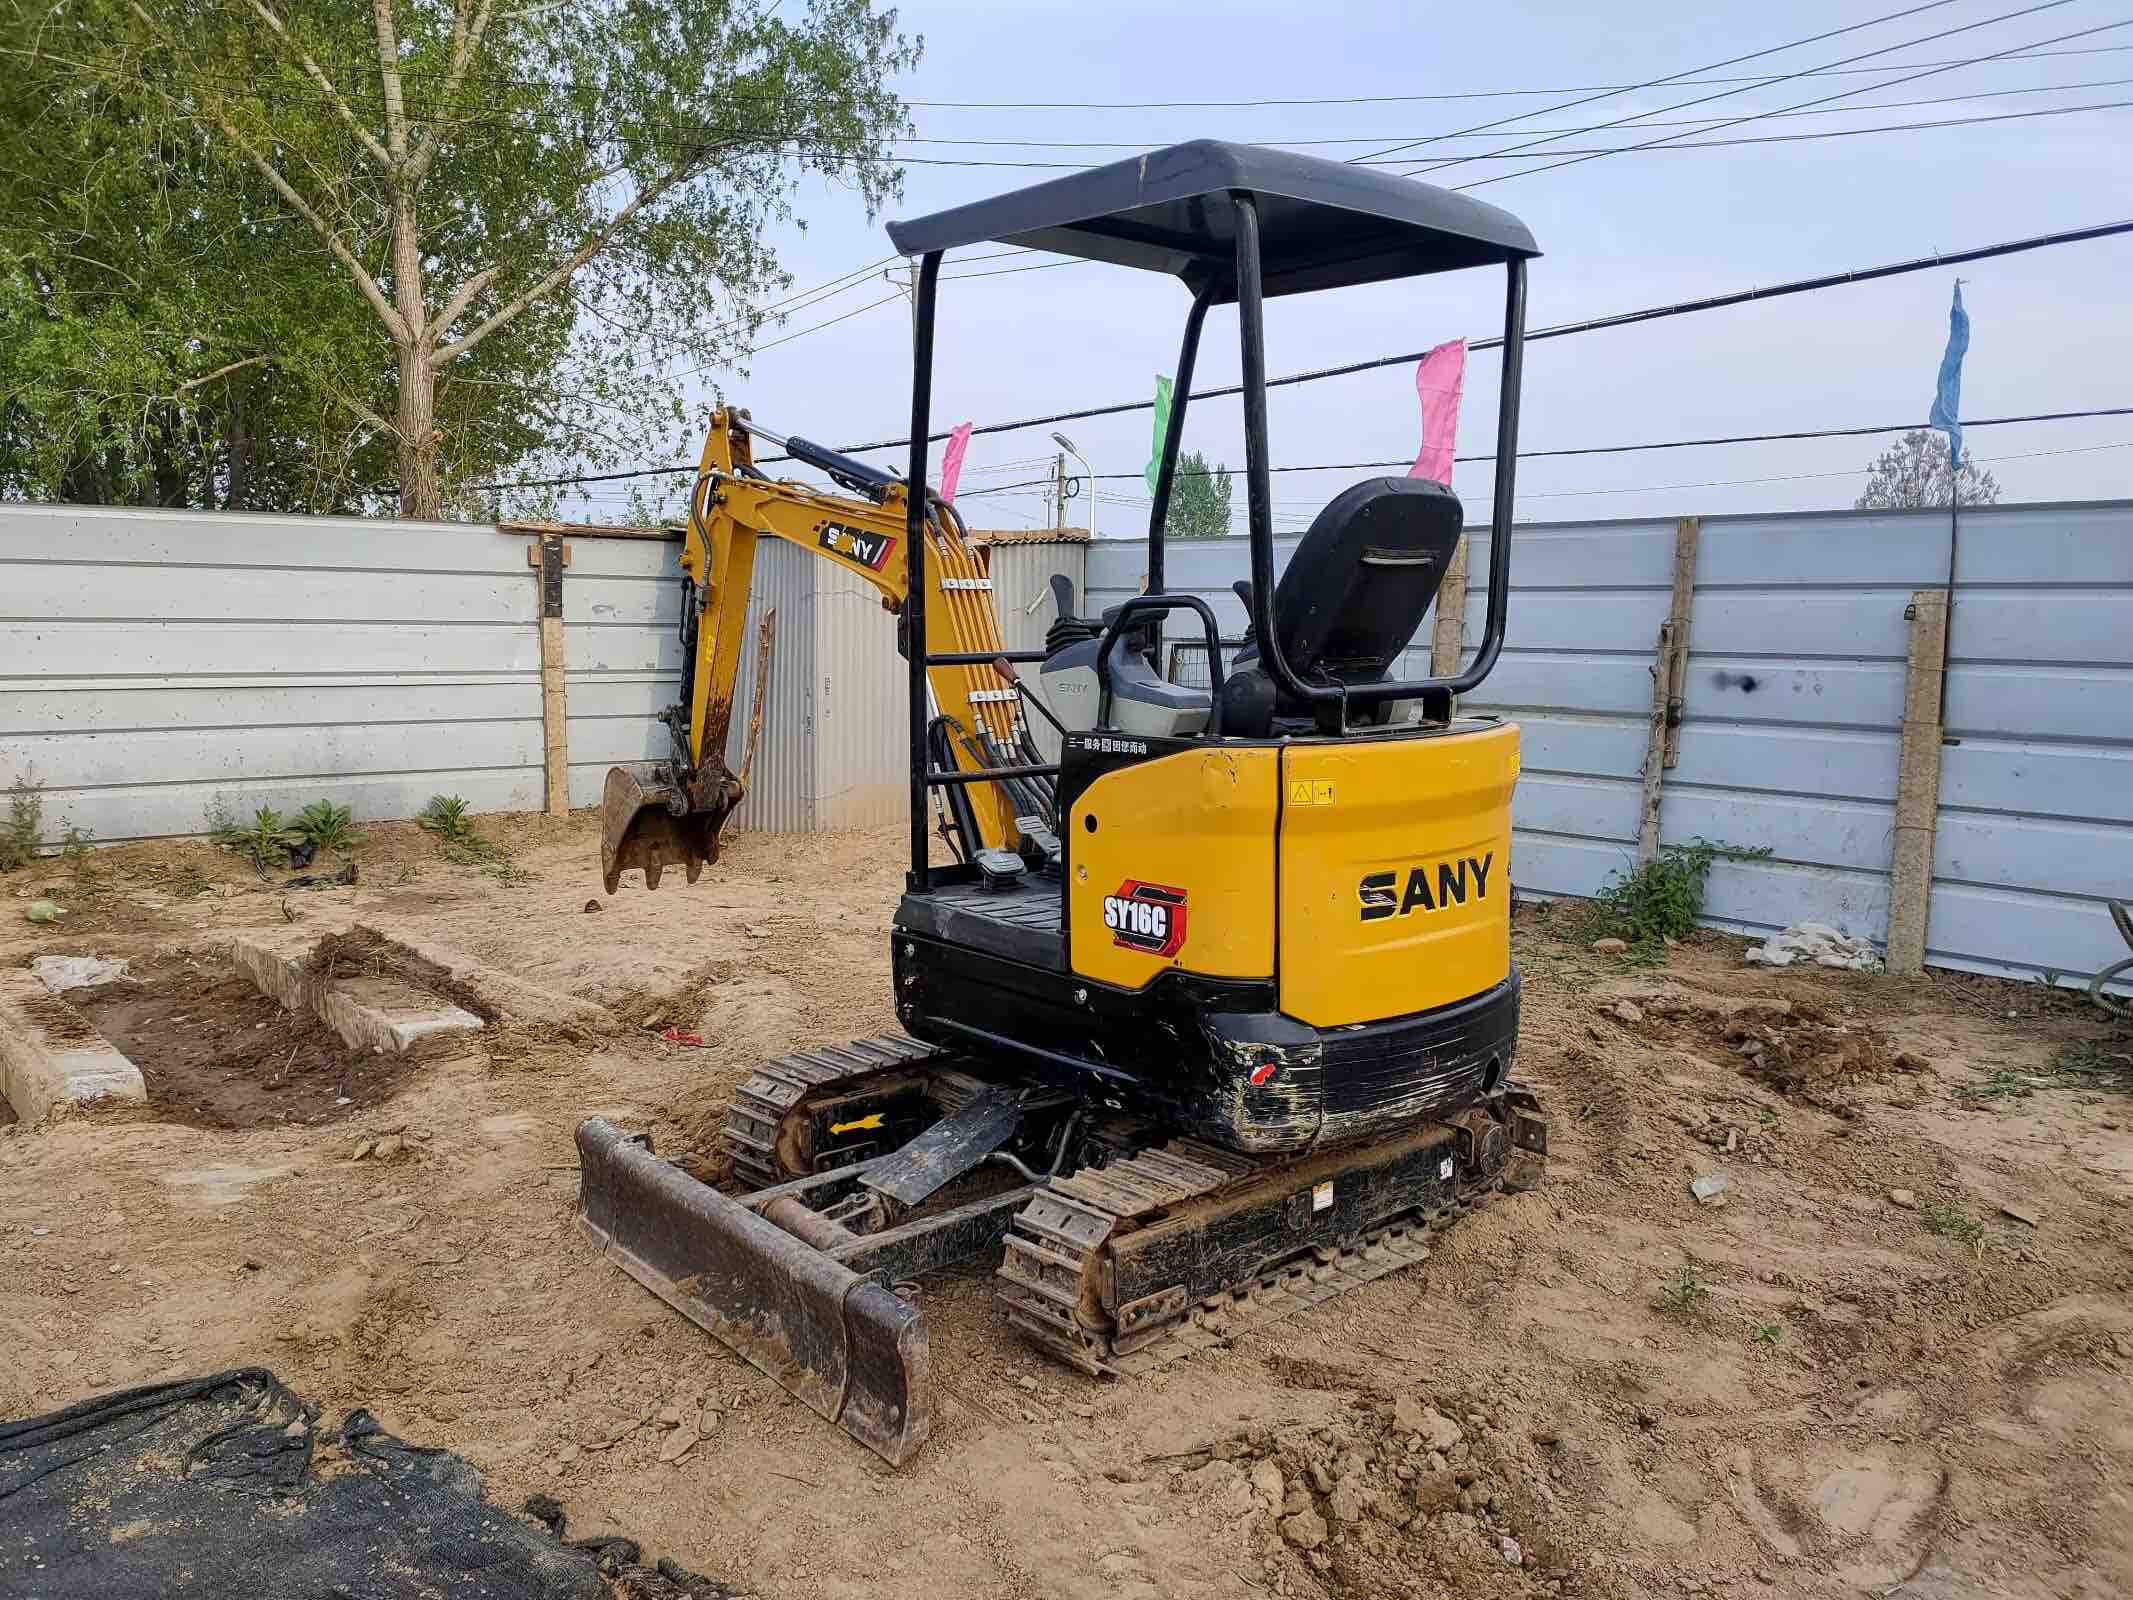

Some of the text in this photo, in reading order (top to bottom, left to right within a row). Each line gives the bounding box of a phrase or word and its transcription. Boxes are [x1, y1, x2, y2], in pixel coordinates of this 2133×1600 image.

[827, 526, 873, 561] SNY
[1359, 850, 1494, 921] SANY
[1104, 896, 1166, 938] SY16C
